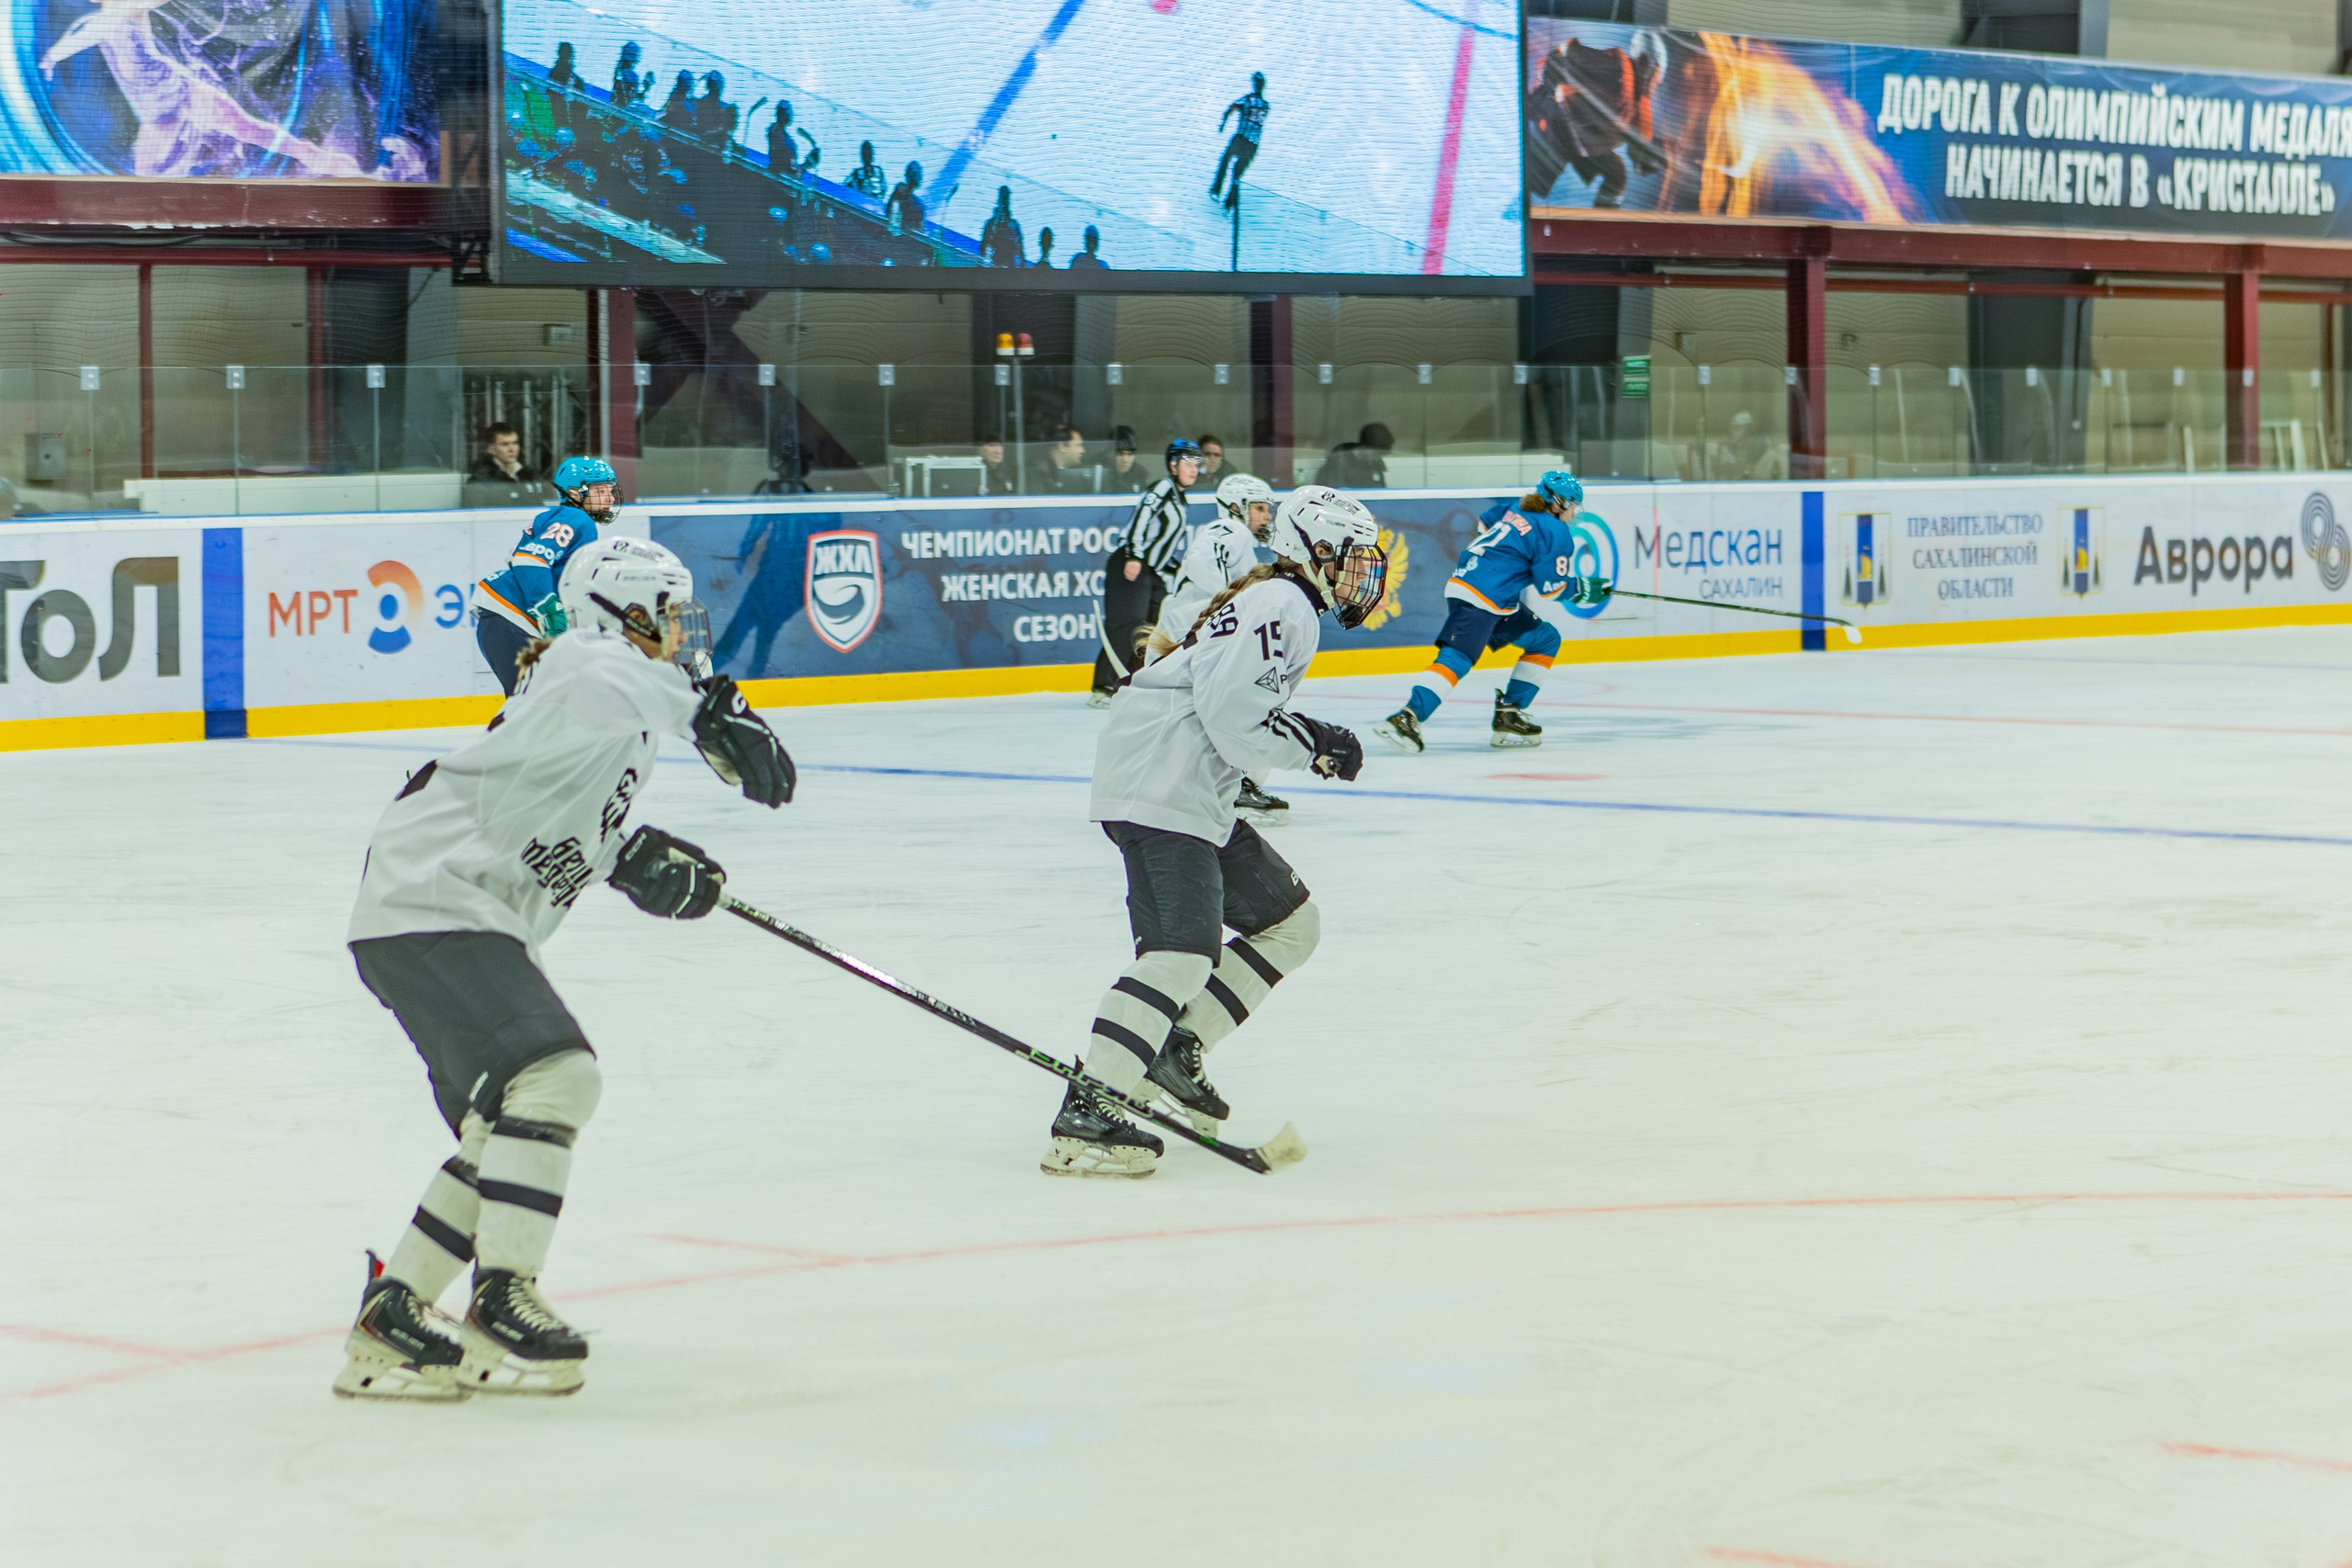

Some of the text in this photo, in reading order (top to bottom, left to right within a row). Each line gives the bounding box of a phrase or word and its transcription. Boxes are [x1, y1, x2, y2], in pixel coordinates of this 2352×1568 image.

[1877, 73, 2352, 160] ДОРОГА К ОЛИМПИЙСКИМ МЕДАЛЯ
[1944, 143, 2336, 217] НАЧИНАЕТСЯ В «КРИСТАЛЛЕ»
[540, 522, 574, 547] 28
[1907, 513, 2042, 538] ПРАВИТЕЛЬСТВО
[901, 525, 1121, 559] ЧЕМПИОНАТ РОС
[1634, 525, 1782, 574] Медскан
[1913, 540, 2038, 569] САХАЛИНСКОЙ
[815, 544, 872, 573] ЖХЛ
[1555, 556, 1569, 577] 8
[2133, 526, 2294, 593] Аврора
[942, 571, 1069, 602] ЖЕНСКАЯ
[1700, 577, 1782, 598] САХАЛИН
[1939, 575, 2013, 601] ОБЛАСТИ
[269, 590, 358, 637] МРТ
[1013, 613, 1096, 642] СЕЗОН
